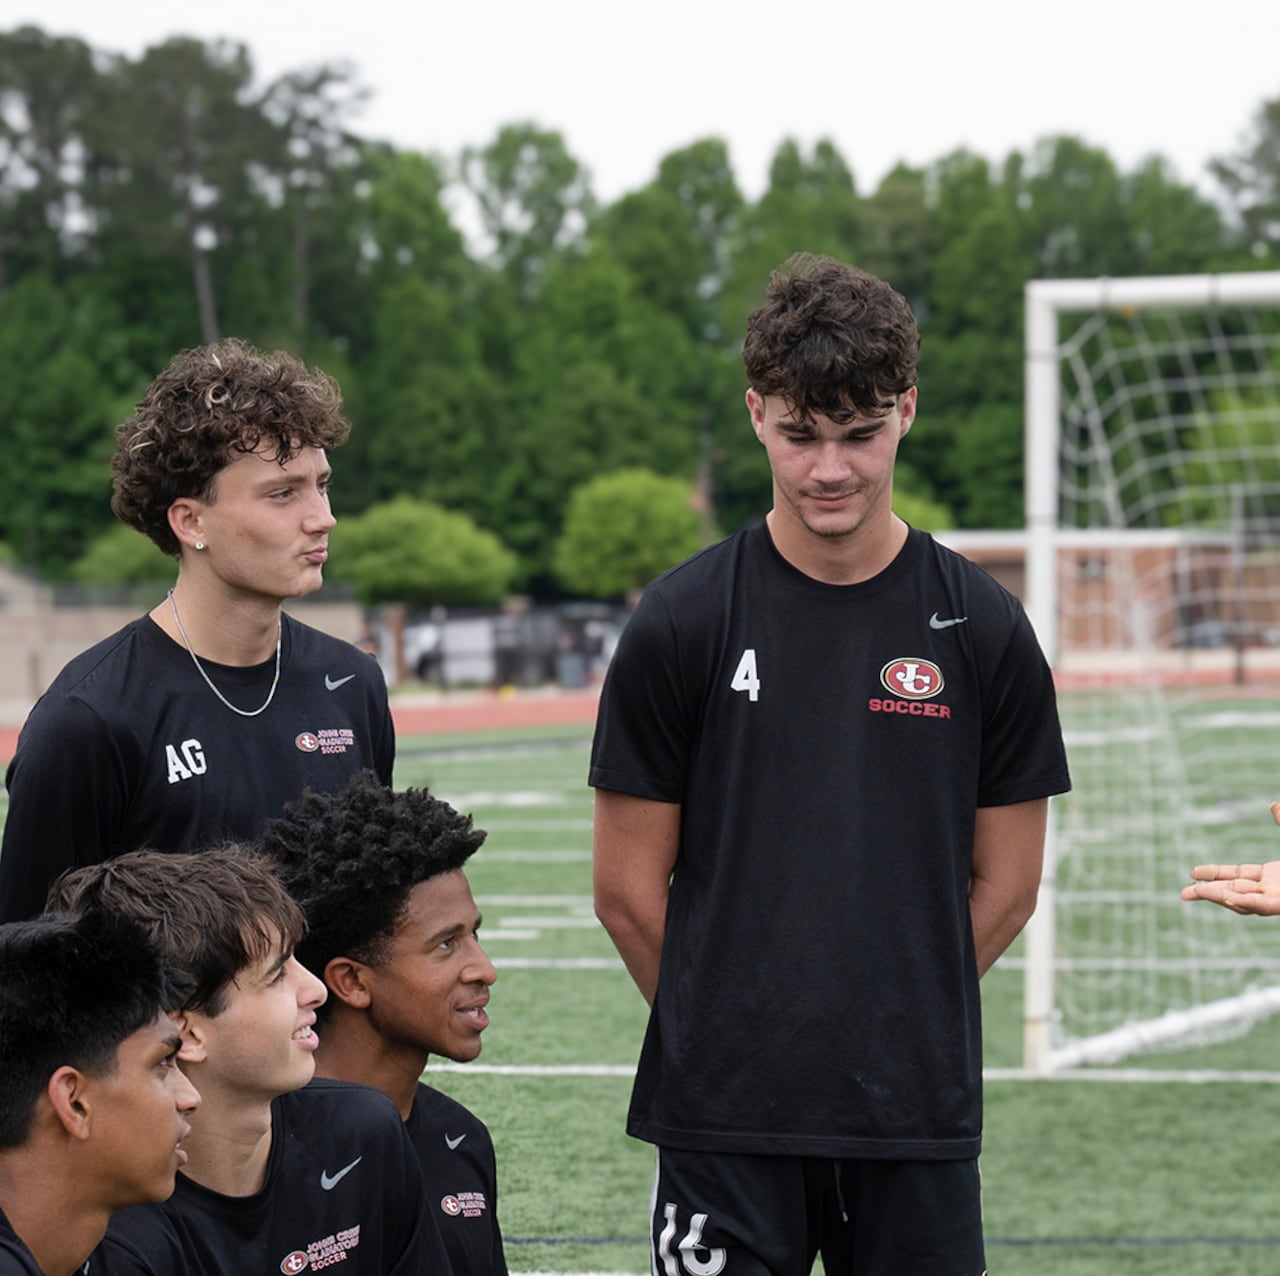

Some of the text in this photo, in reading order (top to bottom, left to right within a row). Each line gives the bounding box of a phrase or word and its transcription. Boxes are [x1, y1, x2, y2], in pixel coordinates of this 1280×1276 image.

[730, 649, 760, 702] 4
[868, 698, 951, 720] SOCCER
[166, 738, 207, 784] AG
[311, 1251, 348, 1271] SOCCER
